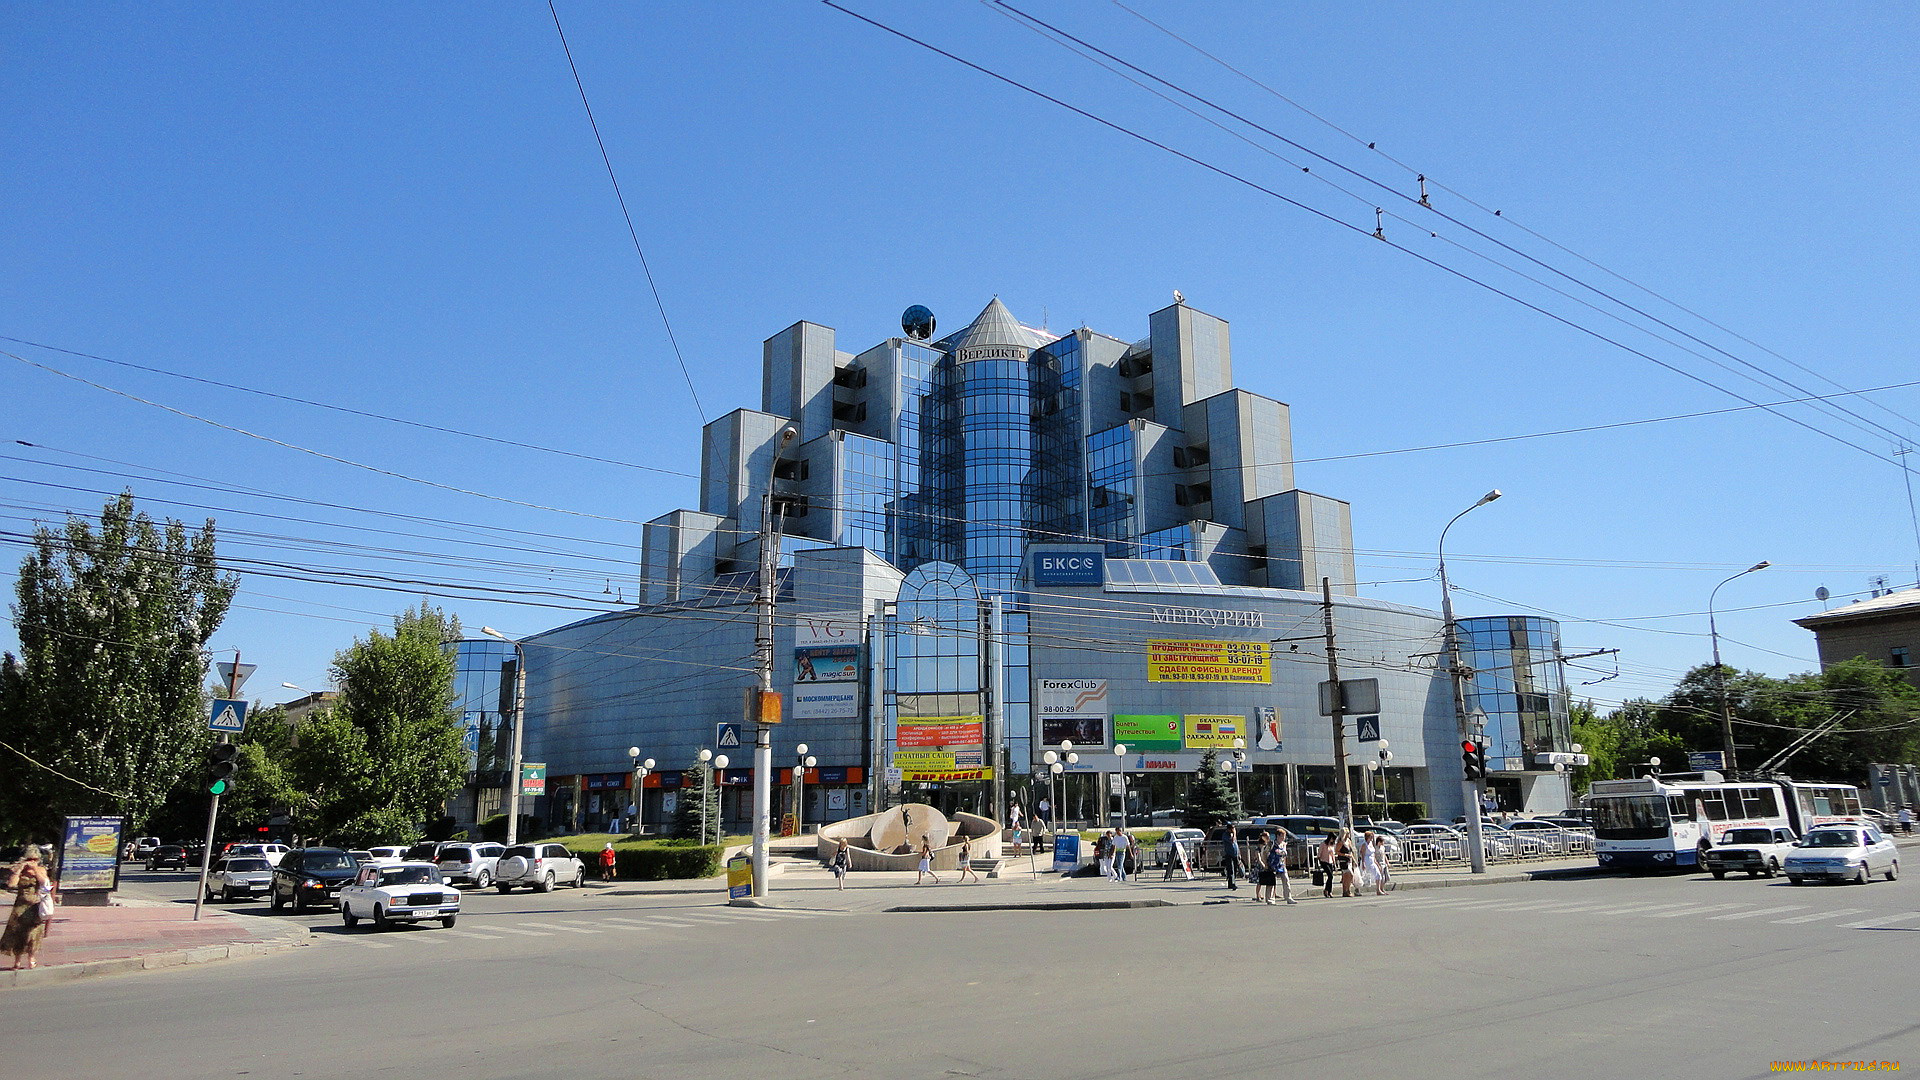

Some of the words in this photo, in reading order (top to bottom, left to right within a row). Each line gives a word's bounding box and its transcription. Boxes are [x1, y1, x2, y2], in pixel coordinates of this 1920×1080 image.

[1151, 607, 1264, 629] МЕРКУРИЙ
[1227, 653, 1263, 665] 93-07-19
[1191, 666, 1221, 674] ОФИСЫ
[1043, 680, 1097, 689] ForexClub
[803, 695, 854, 703] МОСКОММЕРЦБАНК
[1043, 705, 1075, 713] 98-00-29
[895, 752, 930, 760] ПЕЧАТНЫЙ
[1145, 761, 1176, 769] МИАН
[912, 773, 937, 781] МИР
[938, 771, 983, 780] КАМНЕЙ
